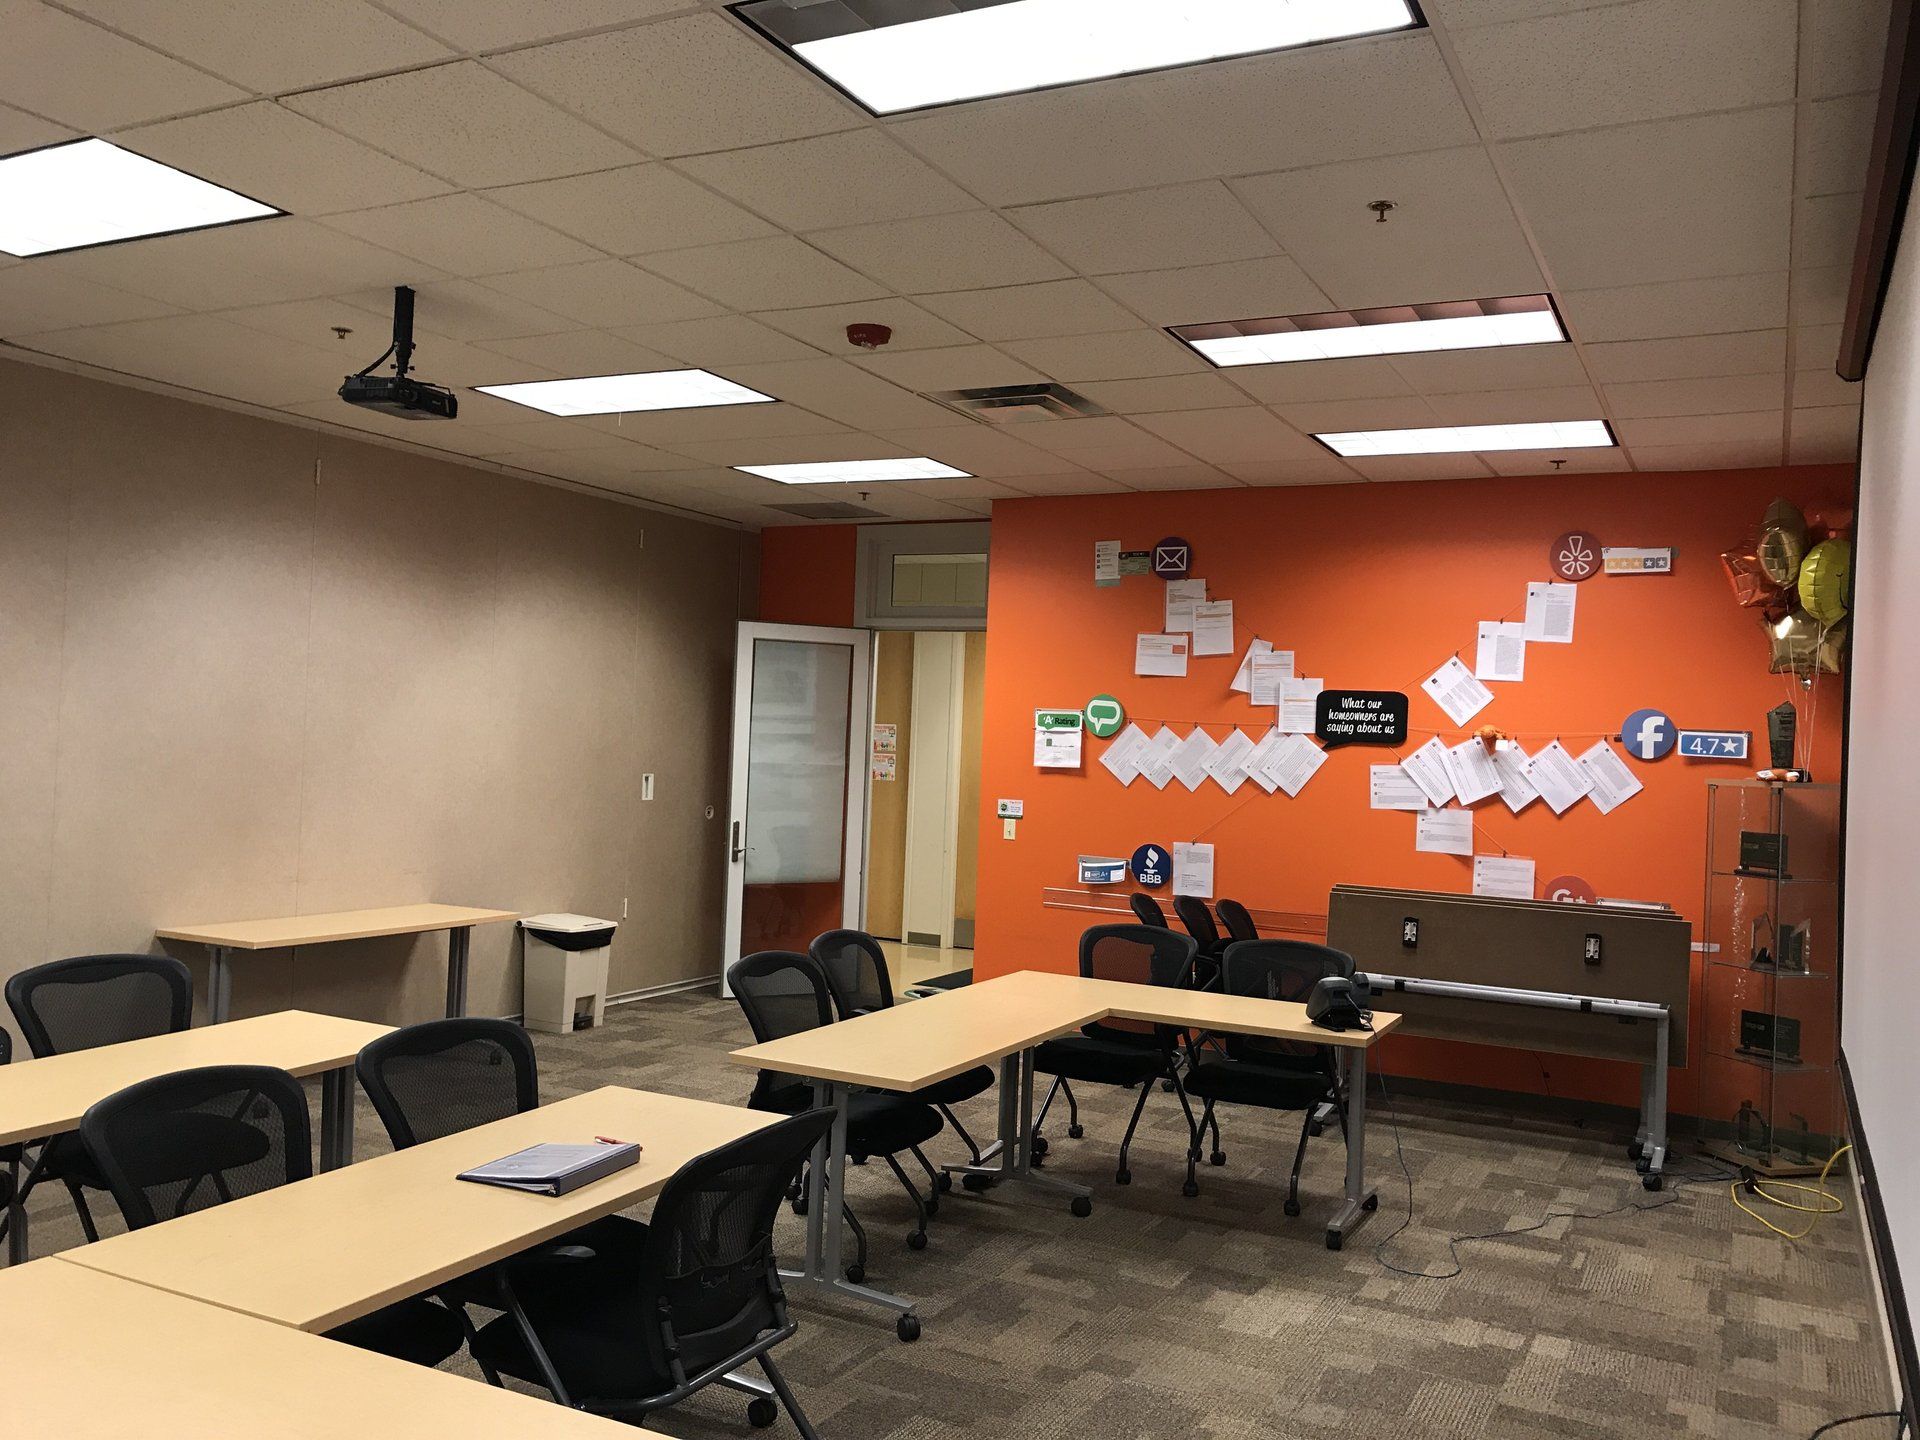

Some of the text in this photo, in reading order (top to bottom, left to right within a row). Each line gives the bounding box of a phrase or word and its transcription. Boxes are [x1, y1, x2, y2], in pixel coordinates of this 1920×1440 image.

[1341, 697, 1383, 709] What our
[1054, 717, 1076, 727] Rating
[1328, 708, 1395, 722] homeowners are
[1326, 721, 1395, 735] saying about us
[1637, 716, 1666, 759] f
[1689, 737, 1720, 755] 4.7
[1139, 873, 1162, 884] BBB
